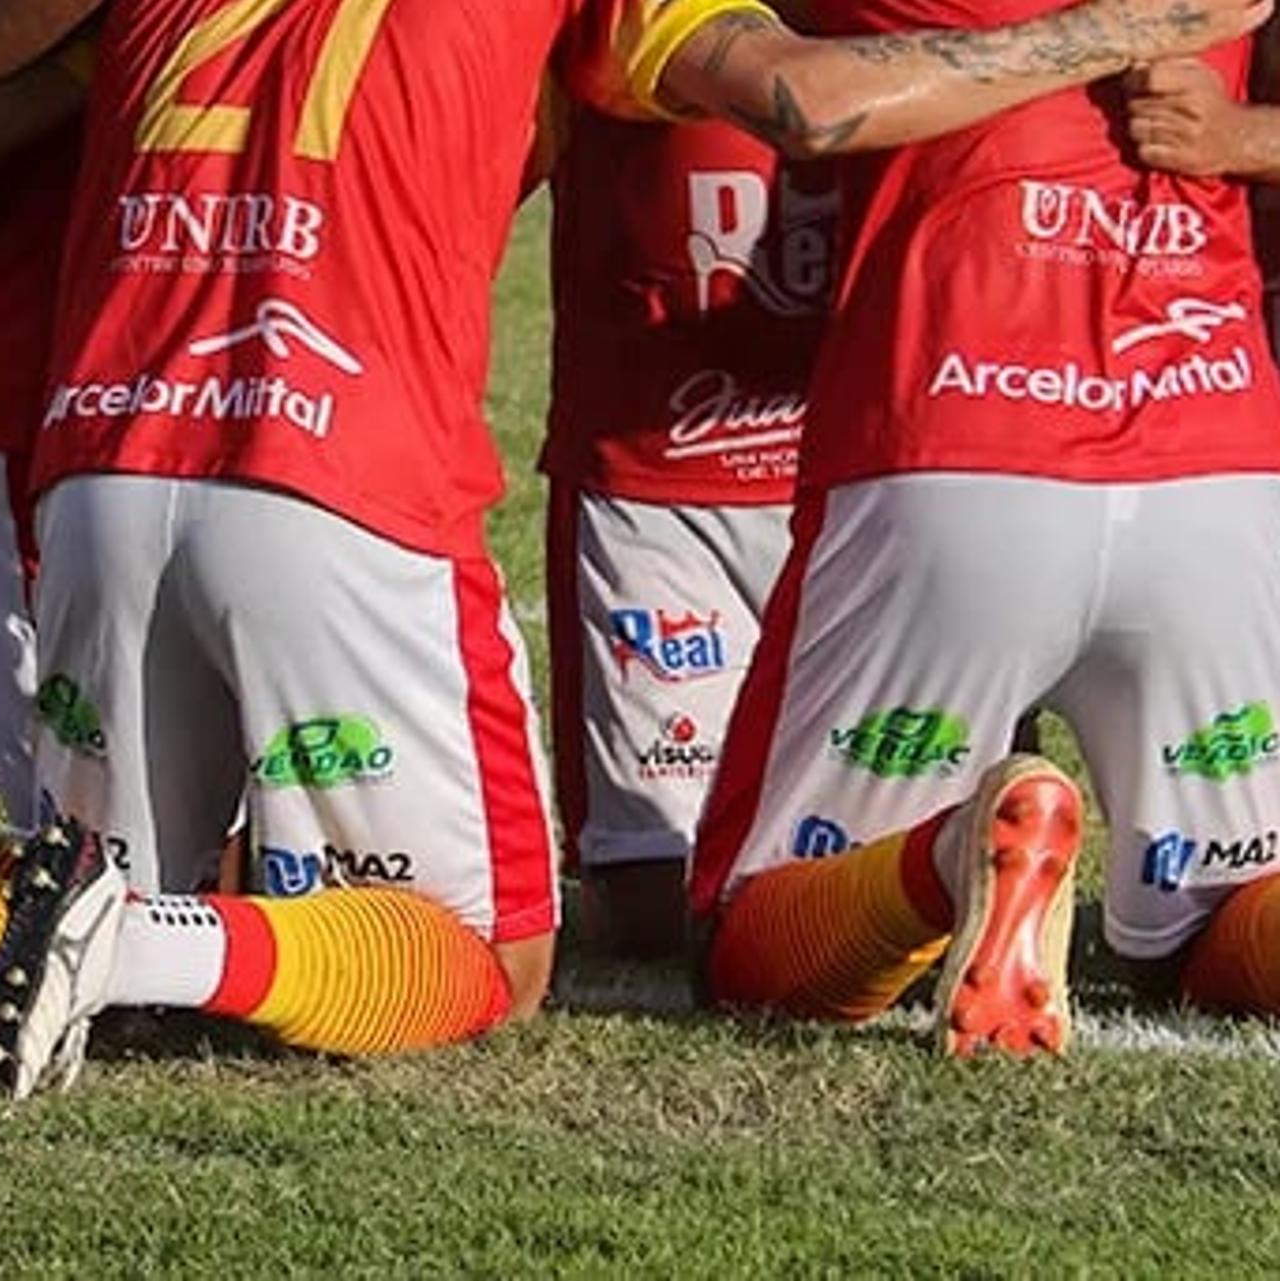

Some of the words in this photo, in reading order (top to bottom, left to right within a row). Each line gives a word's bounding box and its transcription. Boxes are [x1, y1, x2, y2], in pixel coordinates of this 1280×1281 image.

[118, 192, 324, 261] UNIRB
[610, 608, 723, 682] Real
[323, 844, 414, 884] MA2
